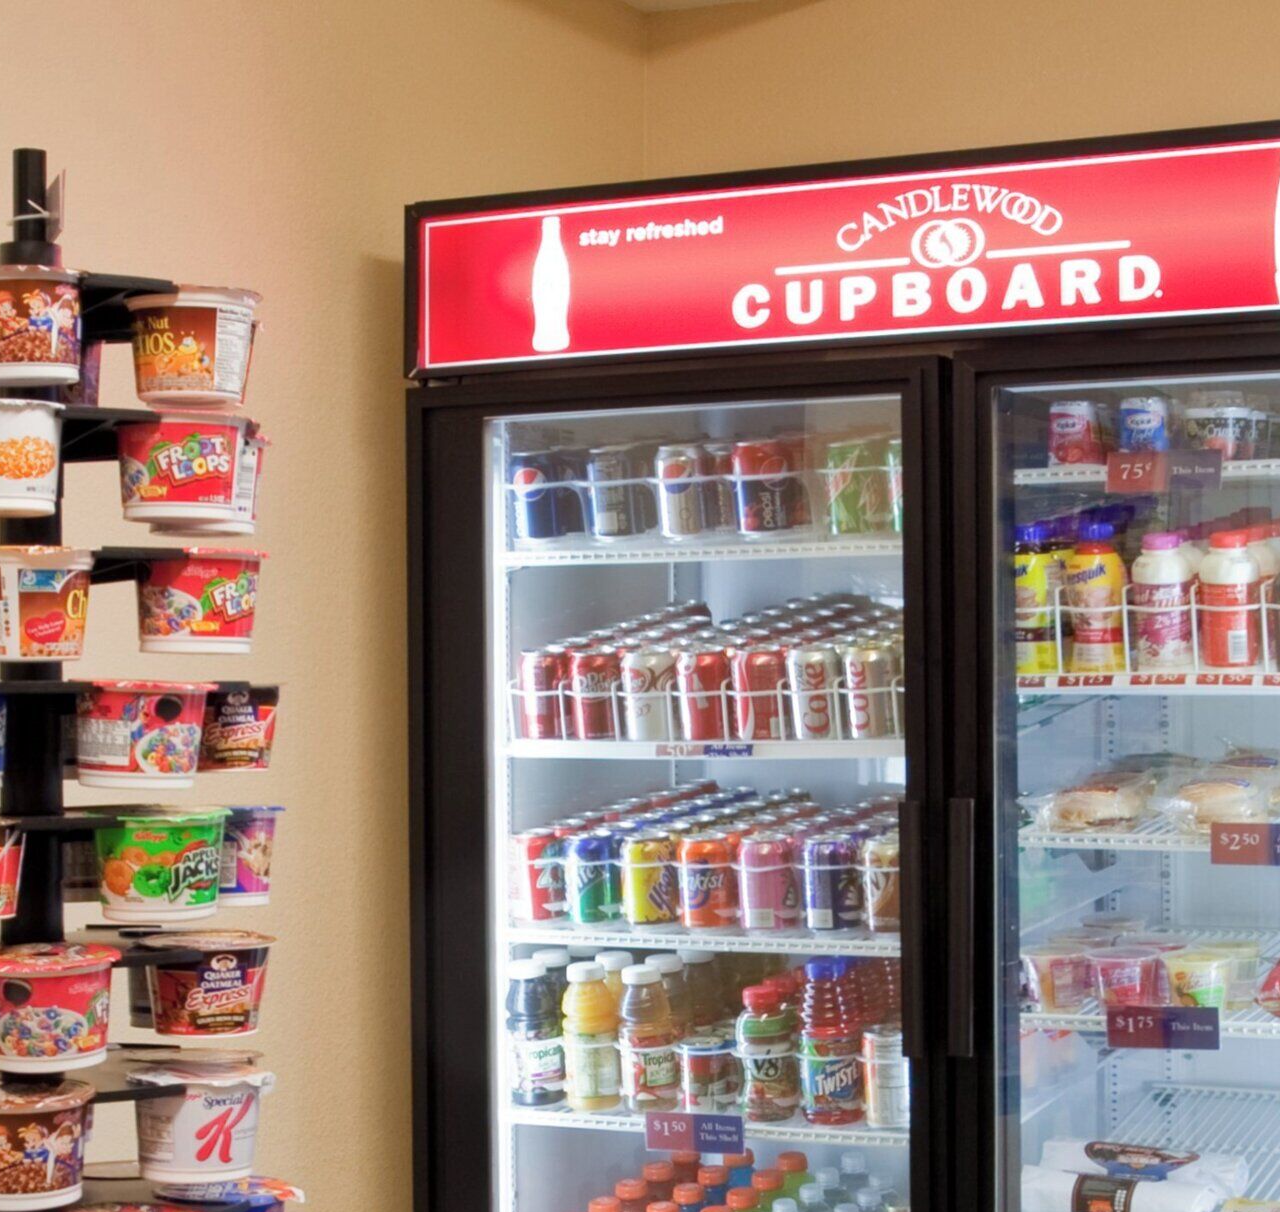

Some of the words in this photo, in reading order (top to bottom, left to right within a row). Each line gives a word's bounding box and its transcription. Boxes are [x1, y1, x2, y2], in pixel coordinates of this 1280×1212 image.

[836, 184, 1063, 252] CANDLEWOOD
[579, 226, 620, 247] stay
[626, 214, 723, 243] refreshed
[732, 255, 1162, 328] CUPBOARD
[147, 316, 169, 330] Nut
[158, 435, 226, 469] FROOT
[172, 454, 231, 480] LOOPS
[1120, 462, 1152, 480] 75¢
[1172, 465, 1192, 475] This
[1195, 465, 1215, 474] Item
[185, 985, 253, 1012] Express
[1171, 1021, 1190, 1031] This
[1192, 1022, 1213, 1031] Item
[203, 1093, 245, 1110] Special
[195, 1092, 255, 1163] K
[699, 1132, 717, 1141] This
[719, 1133, 739, 1142] Shelf
[700, 1122, 713, 1130] All
[714, 1123, 736, 1132] Items
